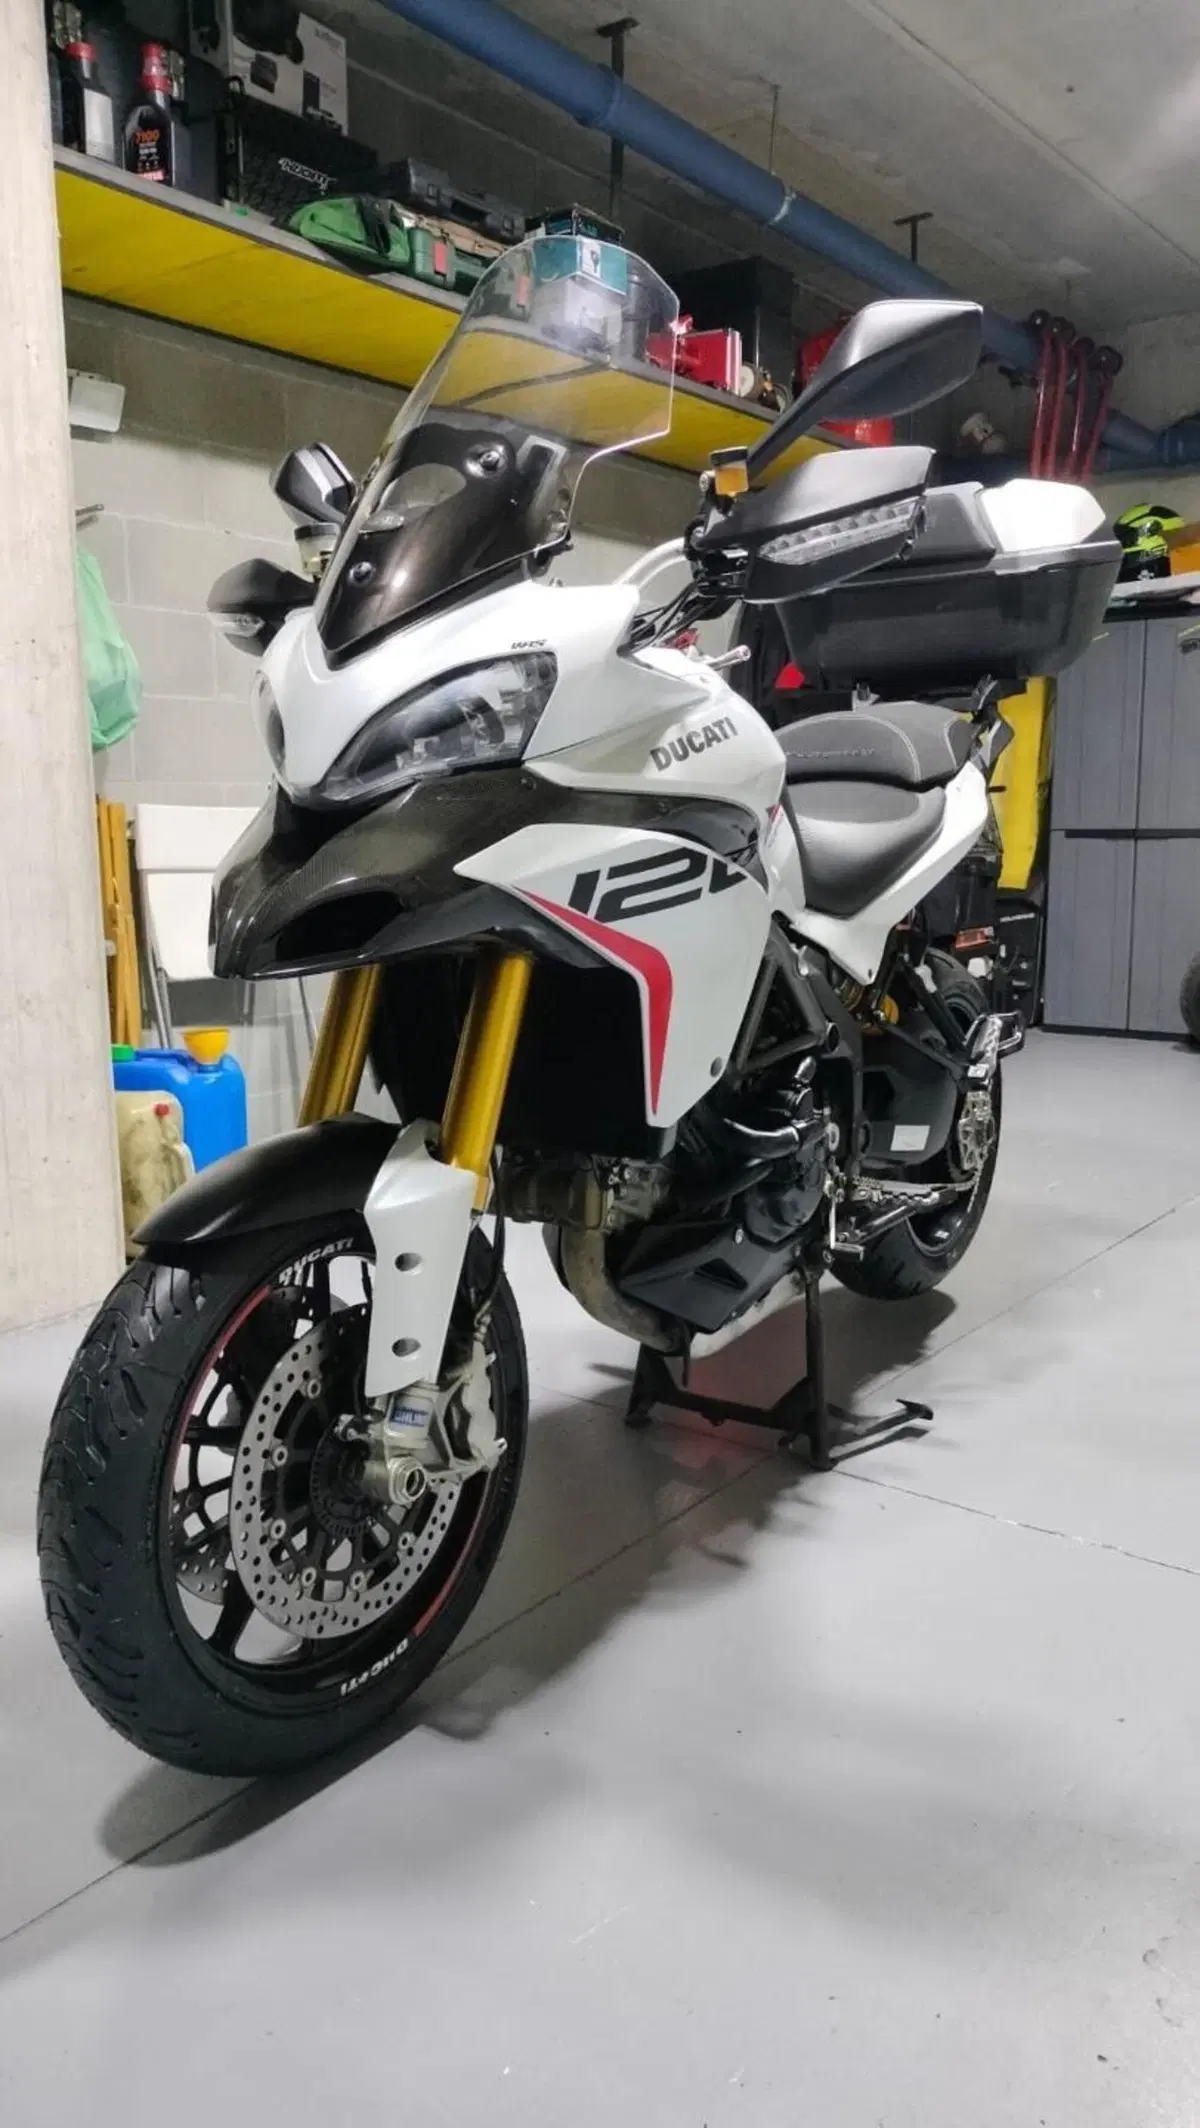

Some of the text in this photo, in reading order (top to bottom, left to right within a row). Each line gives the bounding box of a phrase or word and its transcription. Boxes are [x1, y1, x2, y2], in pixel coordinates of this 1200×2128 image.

[649, 716, 738, 772] DUCATI
[279, 1237, 353, 1286] DUCATI
[341, 1638, 408, 1696] DUCATI
